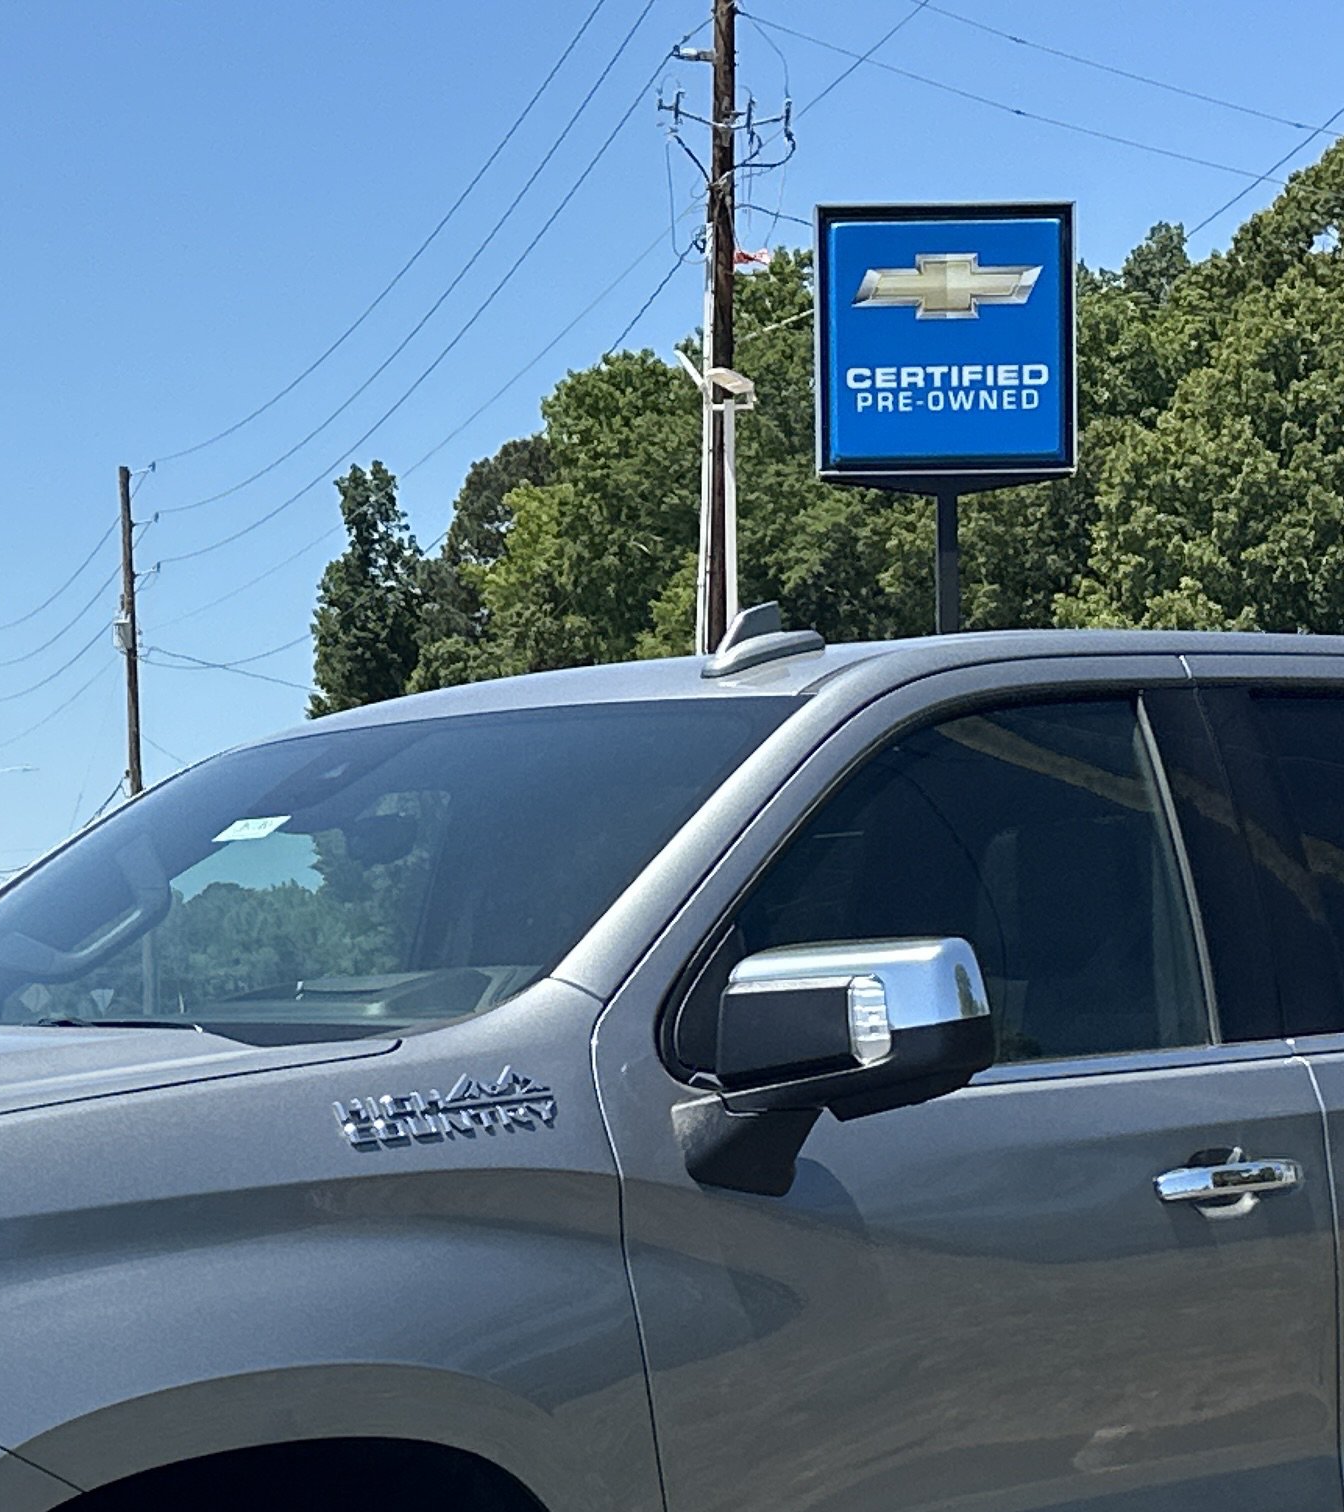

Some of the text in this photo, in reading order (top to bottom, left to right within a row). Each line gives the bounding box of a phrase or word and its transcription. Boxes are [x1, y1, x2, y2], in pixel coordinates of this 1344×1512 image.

[846, 364, 1049, 389] CERTIFIED
[856, 390, 1039, 412] PRE-OWNED
[332, 1089, 445, 1125] HIGH
[343, 1100, 557, 1147] COUNTRY
